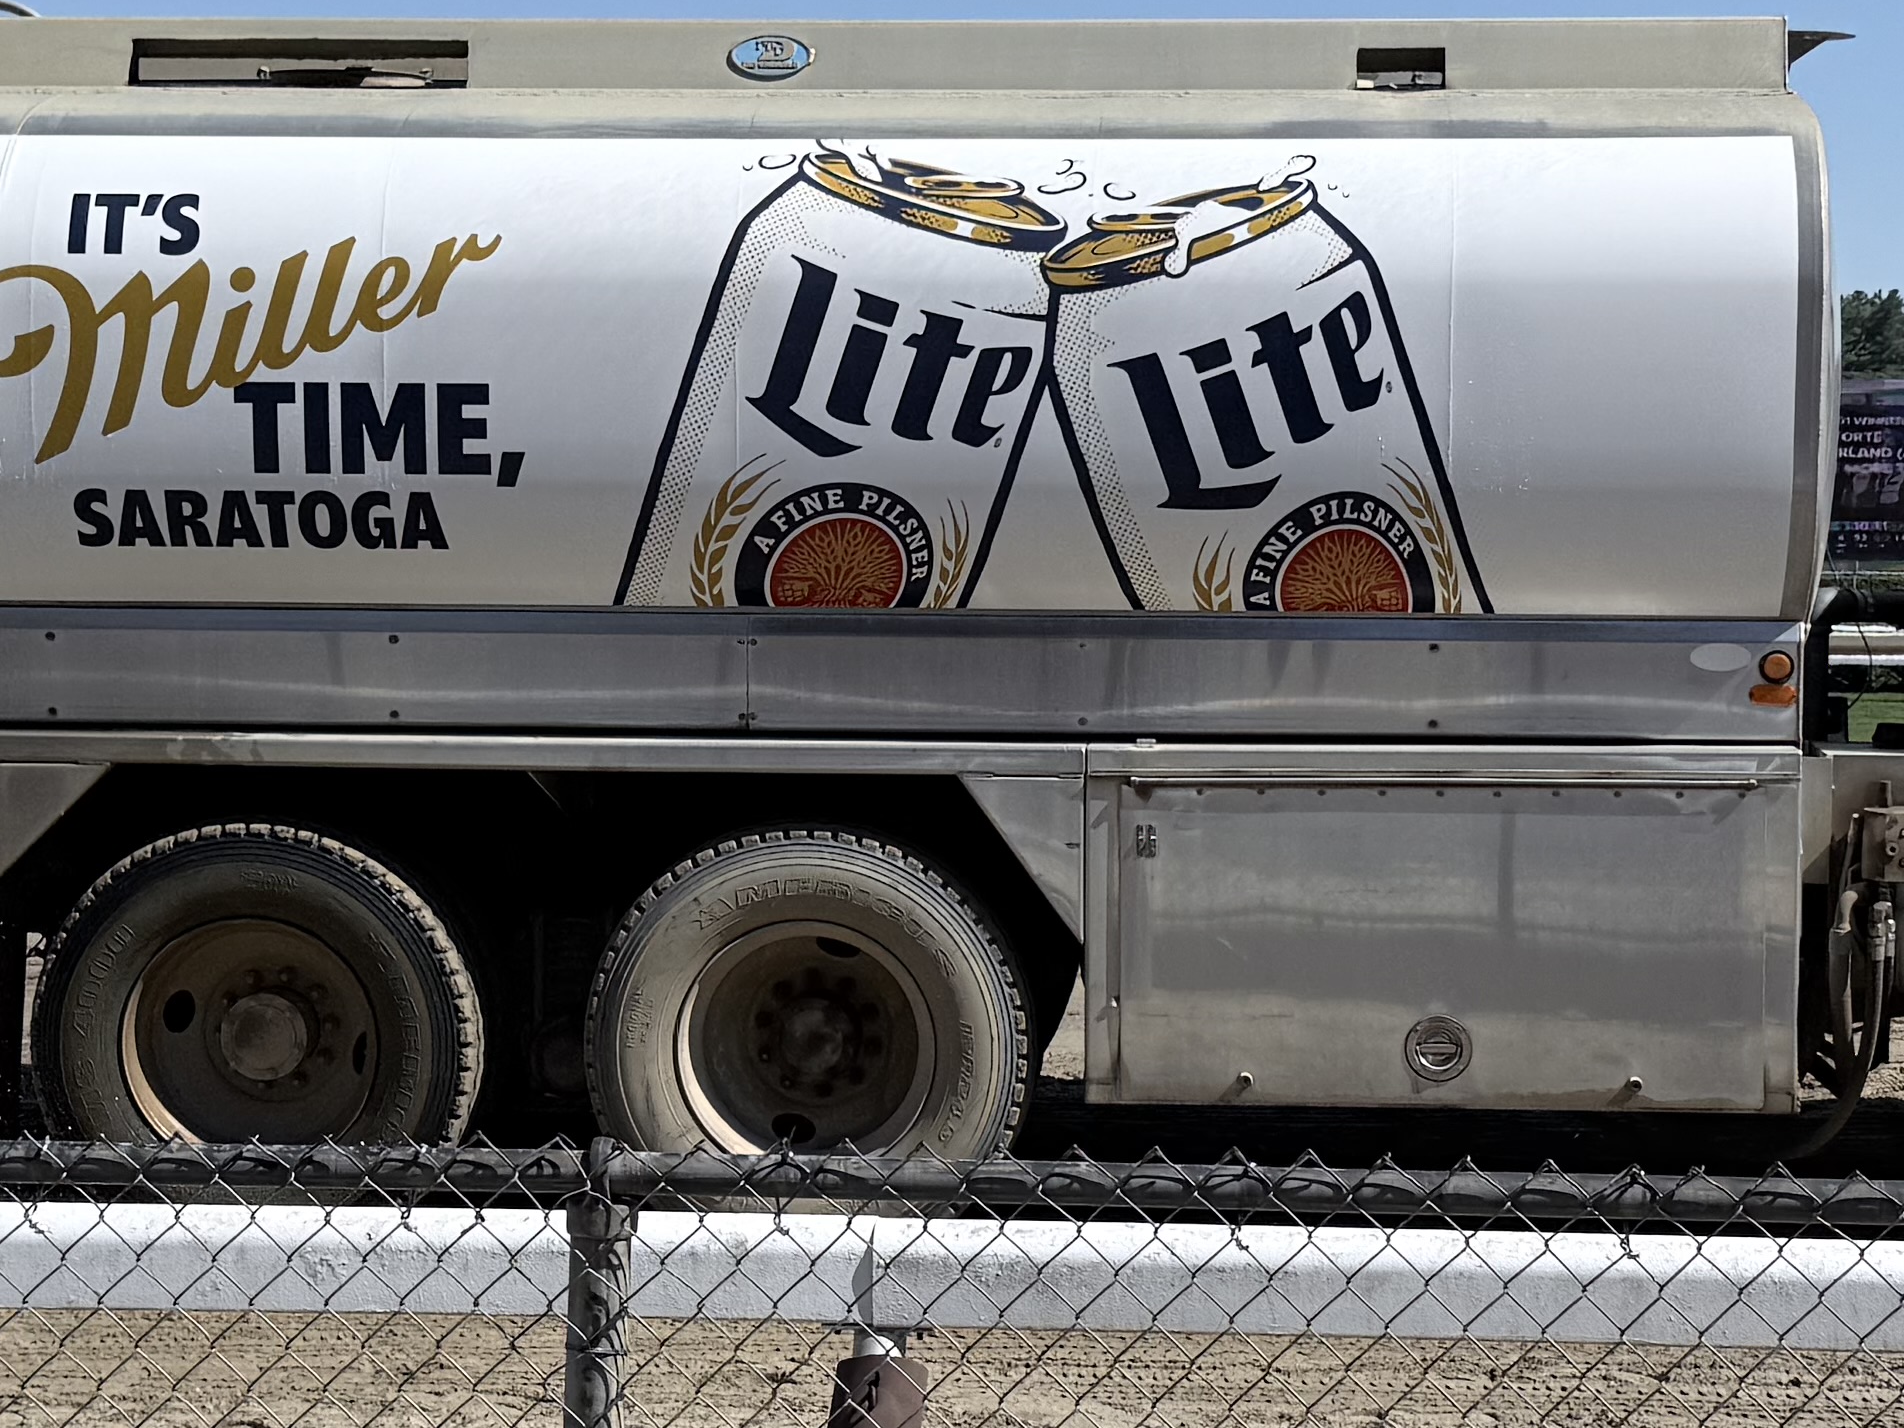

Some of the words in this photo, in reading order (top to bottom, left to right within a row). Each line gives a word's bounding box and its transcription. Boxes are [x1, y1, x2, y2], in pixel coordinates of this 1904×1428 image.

[67, 193, 200, 255] IT'S
[744, 254, 1034, 458] Lite
[1106, 290, 1385, 510] Lite
[233, 381, 526, 488] TIME,
[1840, 430, 1883, 444] ORTE
[72, 488, 450, 550] SARATOGA
[753, 534, 776, 554] A
[770, 489, 845, 533] FINE
[858, 490, 929, 582] PILSNER
[1309, 498, 1415, 560] PILSNER
[1250, 520, 1304, 584] FINE
[1249, 591, 1271, 606] A
